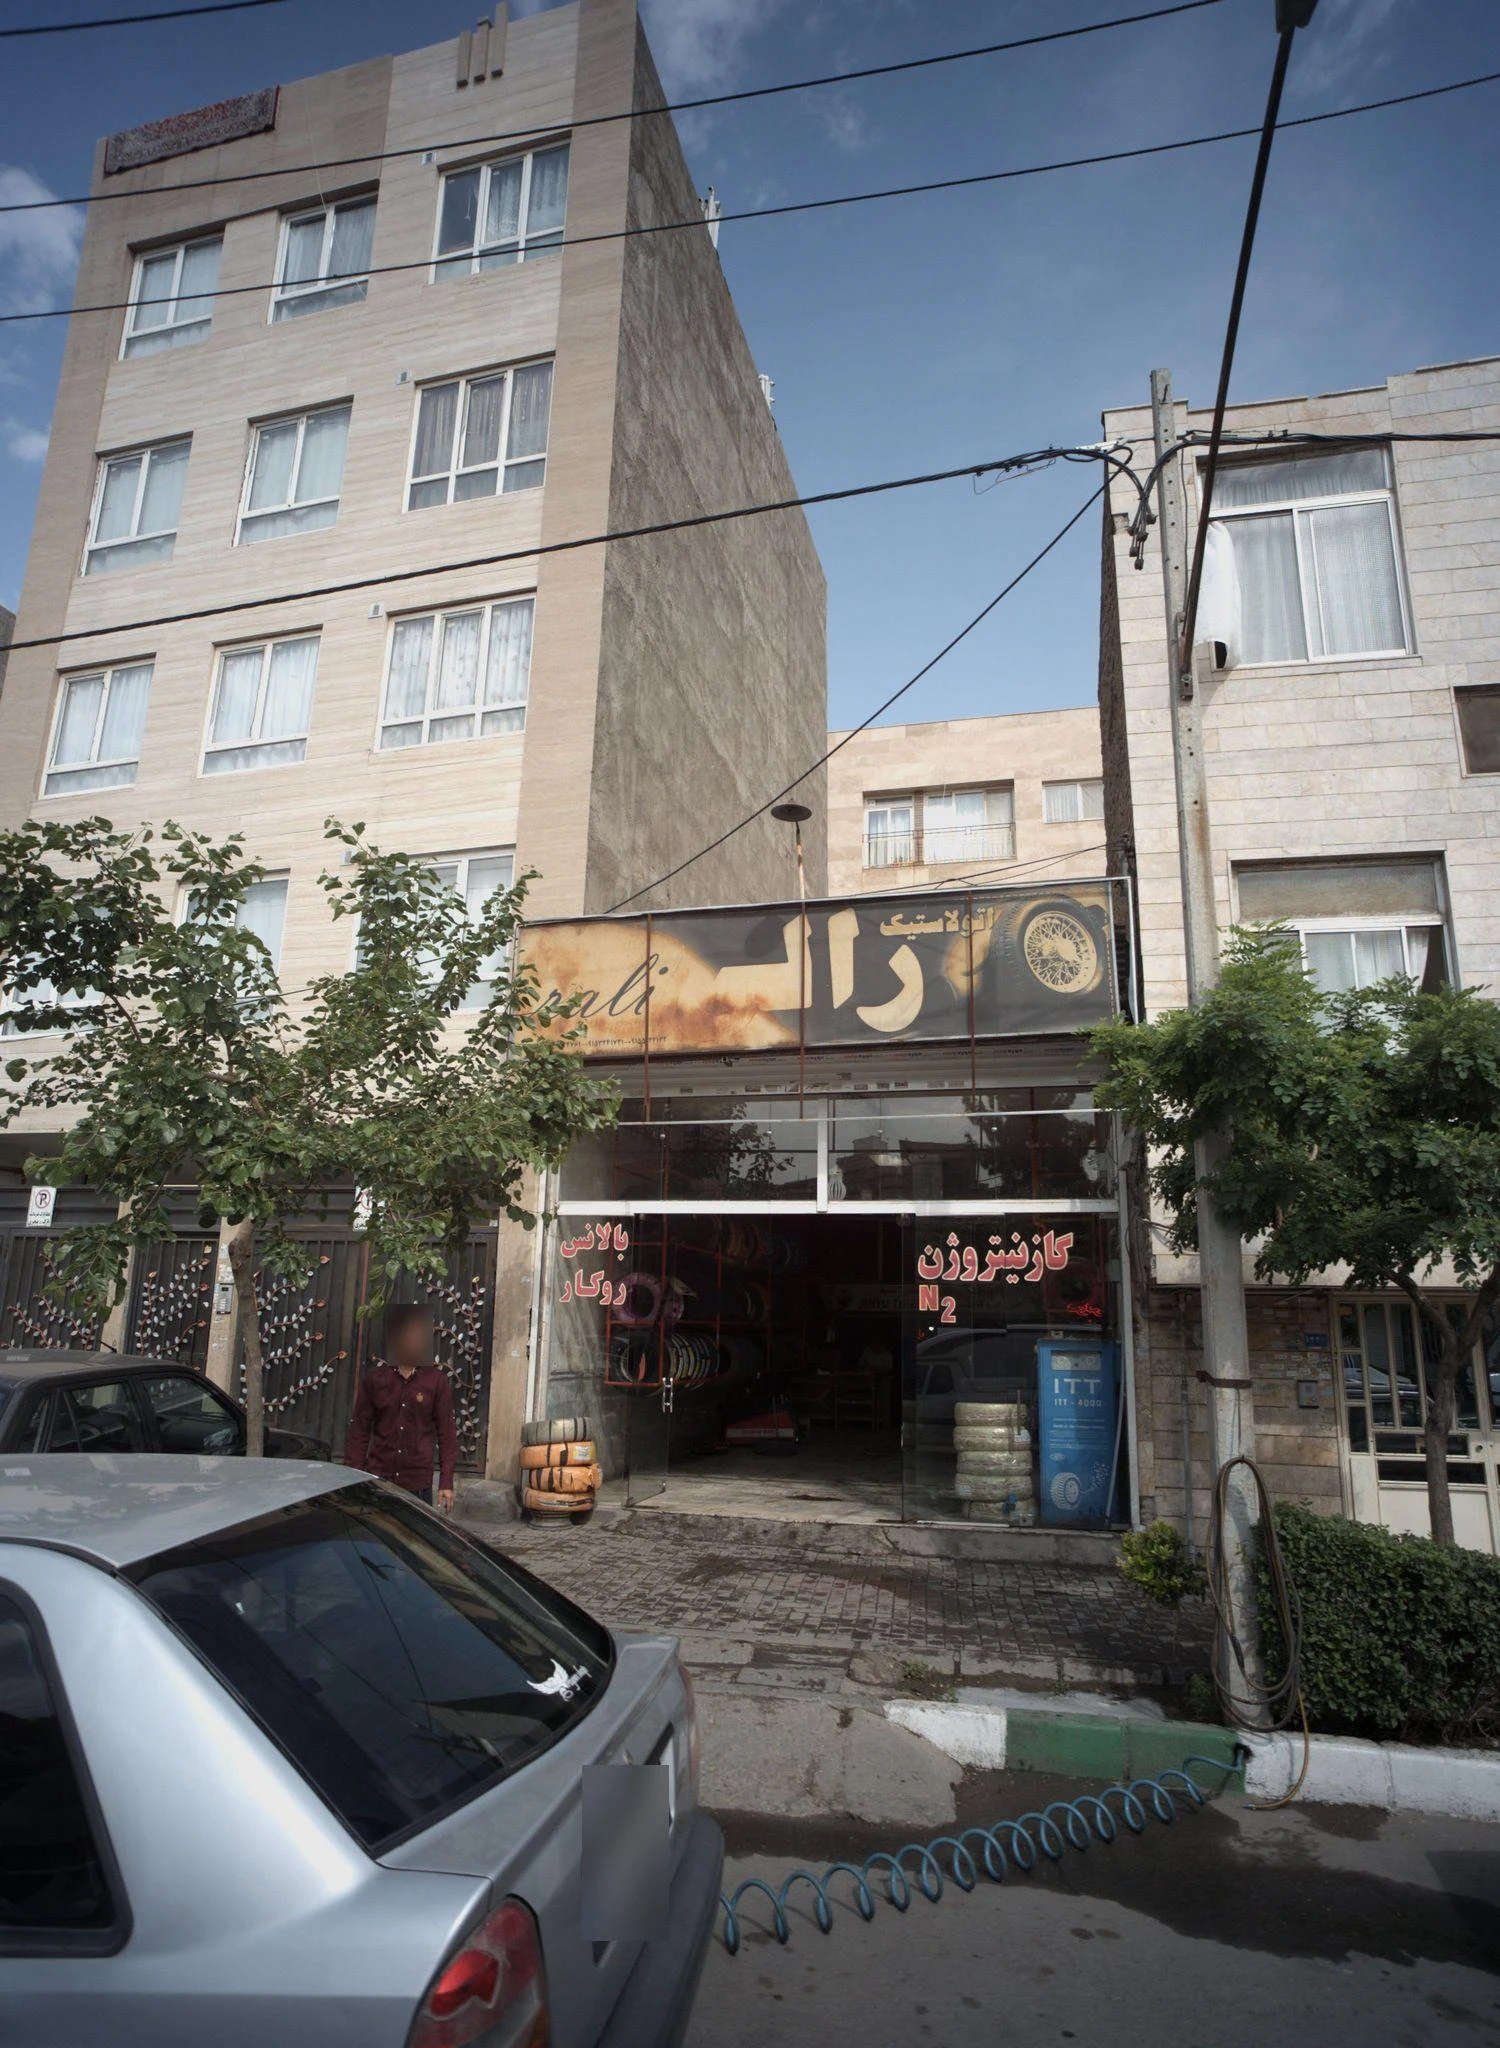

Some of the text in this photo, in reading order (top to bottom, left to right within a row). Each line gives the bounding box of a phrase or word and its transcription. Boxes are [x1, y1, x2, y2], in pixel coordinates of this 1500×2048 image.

[560, 1222, 629, 1261] بالانس
[559, 1268, 627, 1306] روکار
[1053, 1378, 1102, 1395] ITT
